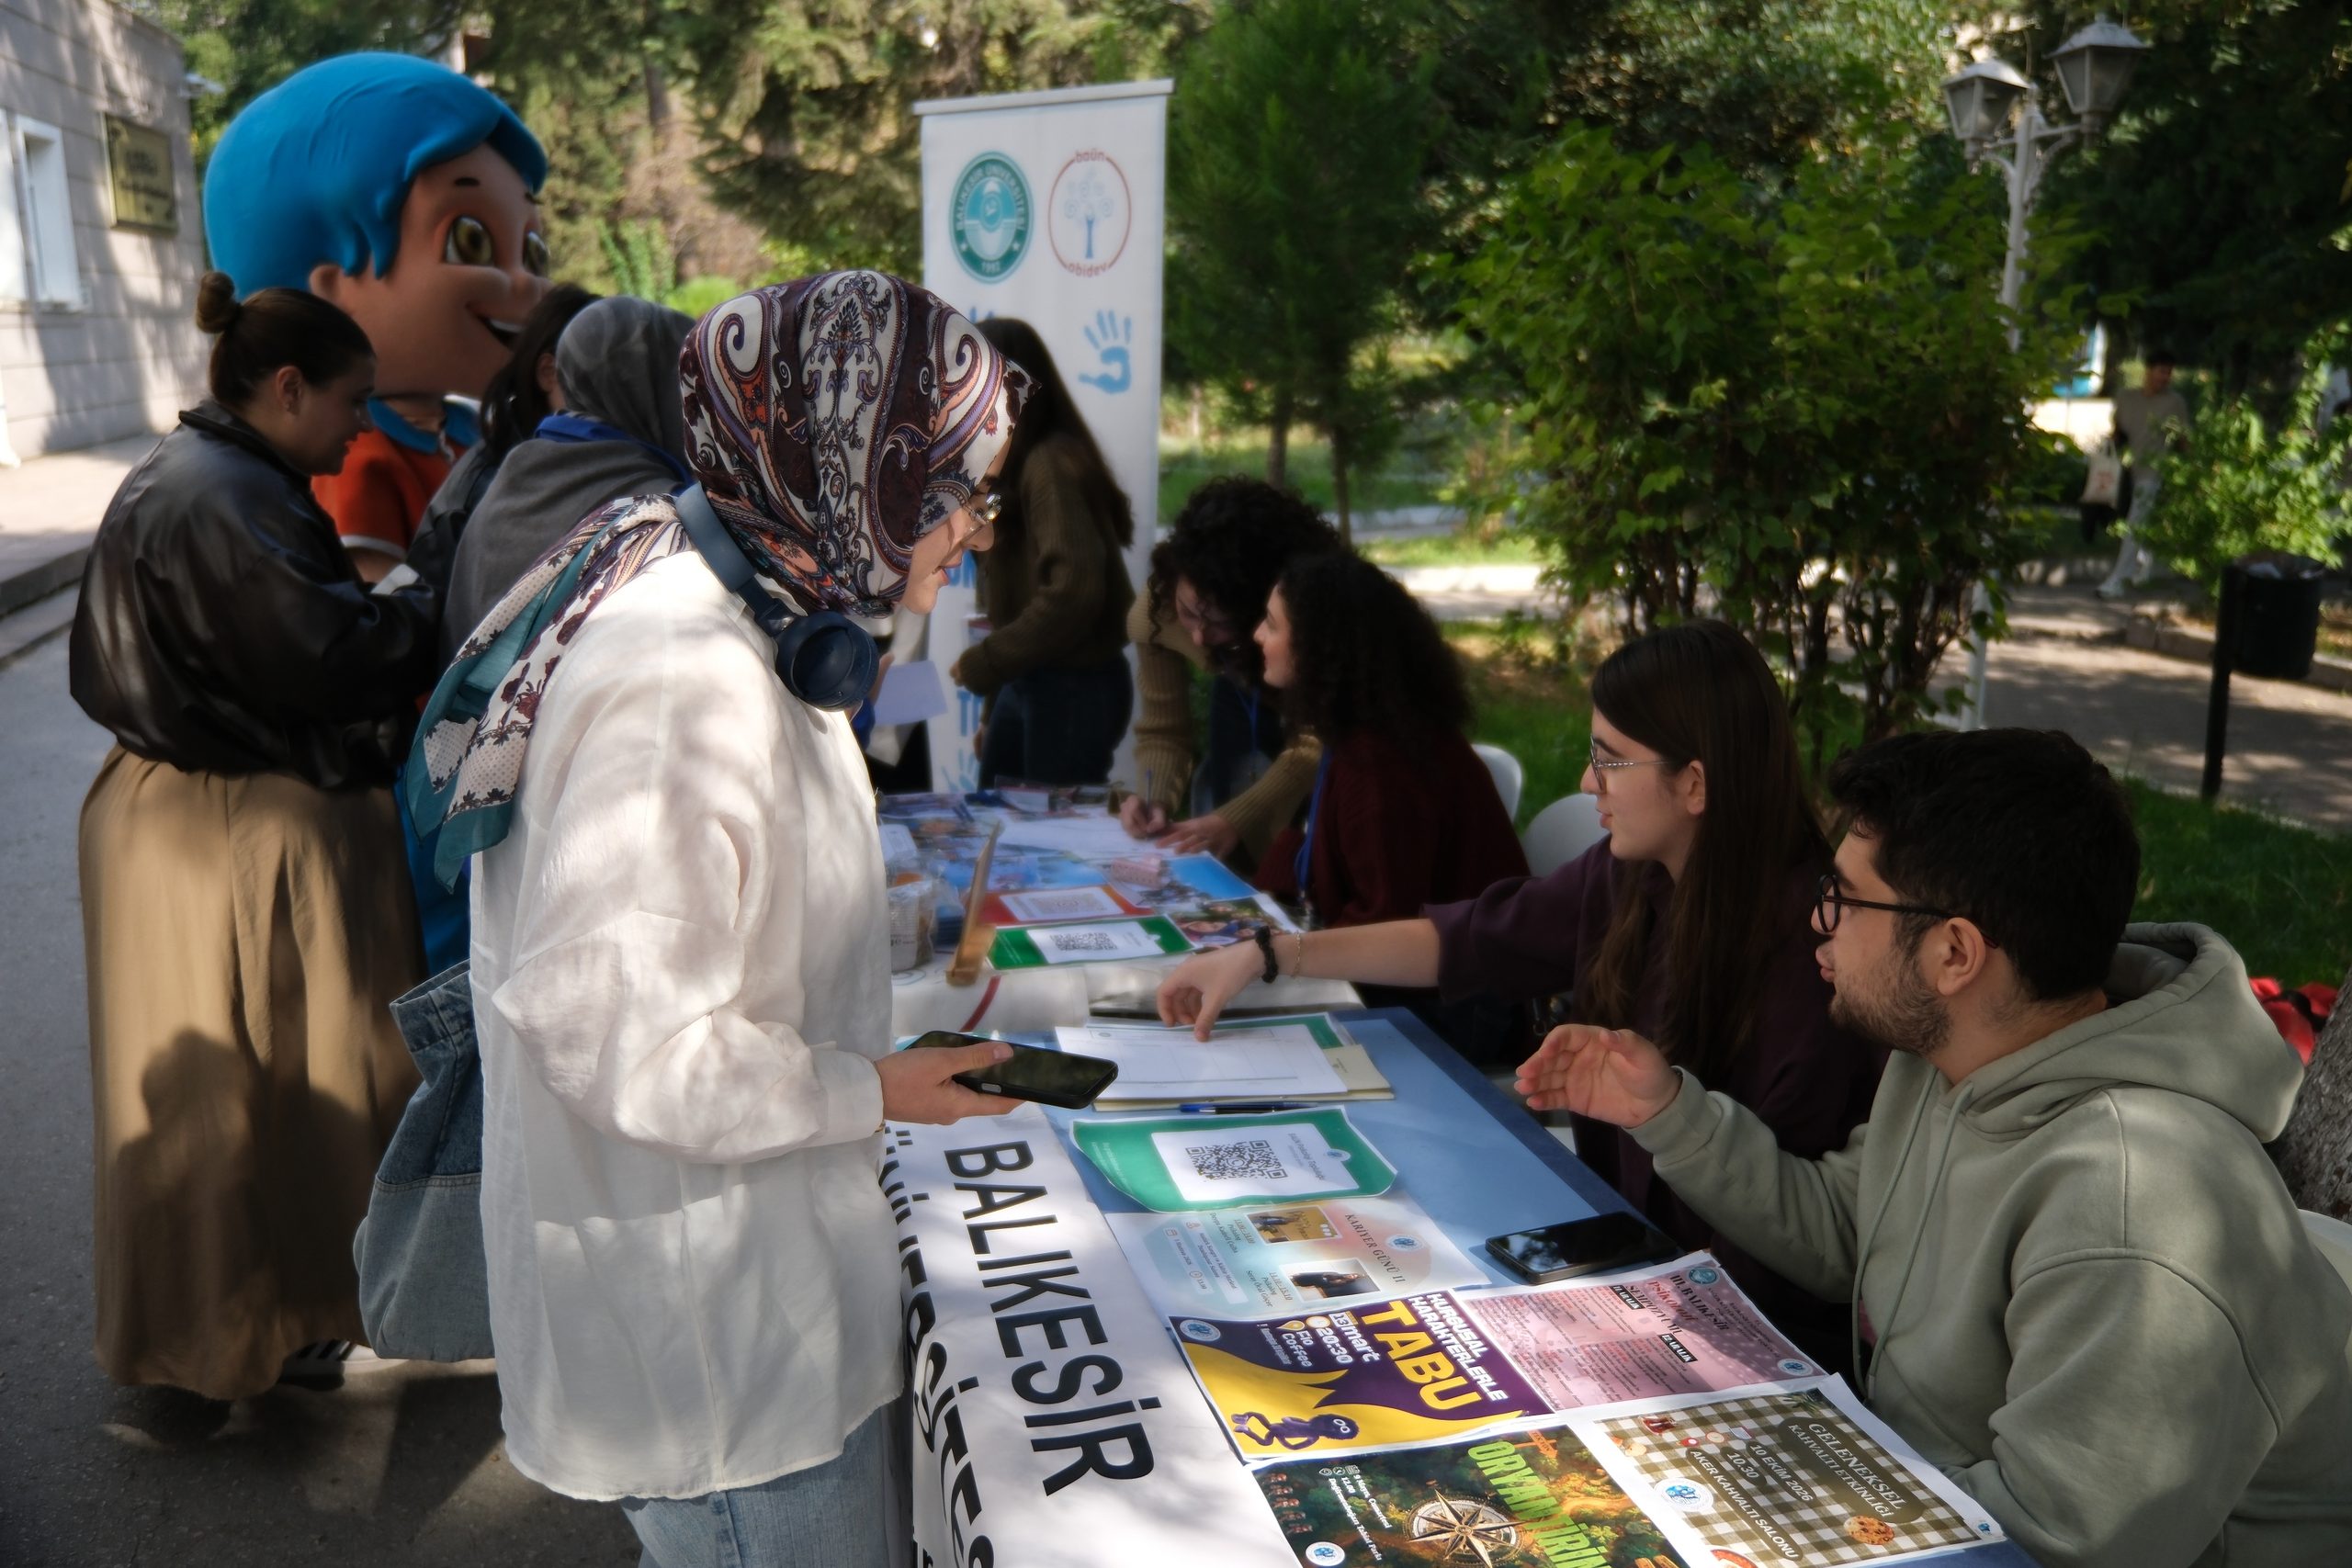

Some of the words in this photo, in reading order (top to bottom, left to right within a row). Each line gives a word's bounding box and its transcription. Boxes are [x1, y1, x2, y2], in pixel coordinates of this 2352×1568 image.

[1345, 1214, 1378, 1248] KARİYER
[1374, 1249, 1398, 1273] GÜNÜ
[944, 1140, 1161, 1496] BALIKESİR
[1282, 1333, 1313, 1367] Coffee
[1316, 1327, 1353, 1363] 20:30
[1343, 1325, 1381, 1362] mart
[1408, 1296, 1509, 1401] KARAKTERLERLE
[1427, 1293, 1487, 1358] KURGUSAL
[1362, 1301, 1482, 1410] TABU
[1726, 1451, 1759, 1479] 10.30
[1749, 1444, 1767, 1456] 10
[1762, 1456, 1791, 1480] EKİM
[1785, 1478, 1814, 1502] 2026
[1789, 1425, 1839, 1471] KAHVALTI
[1837, 1469, 1894, 1517] ETKİNLİĞİ
[1808, 1424, 1907, 1509] GELENEKSEL
[1690, 1450, 1721, 1476] AKER
[1713, 1473, 1760, 1519] KAHVALTI
[1755, 1518, 1799, 1559] SALONU
